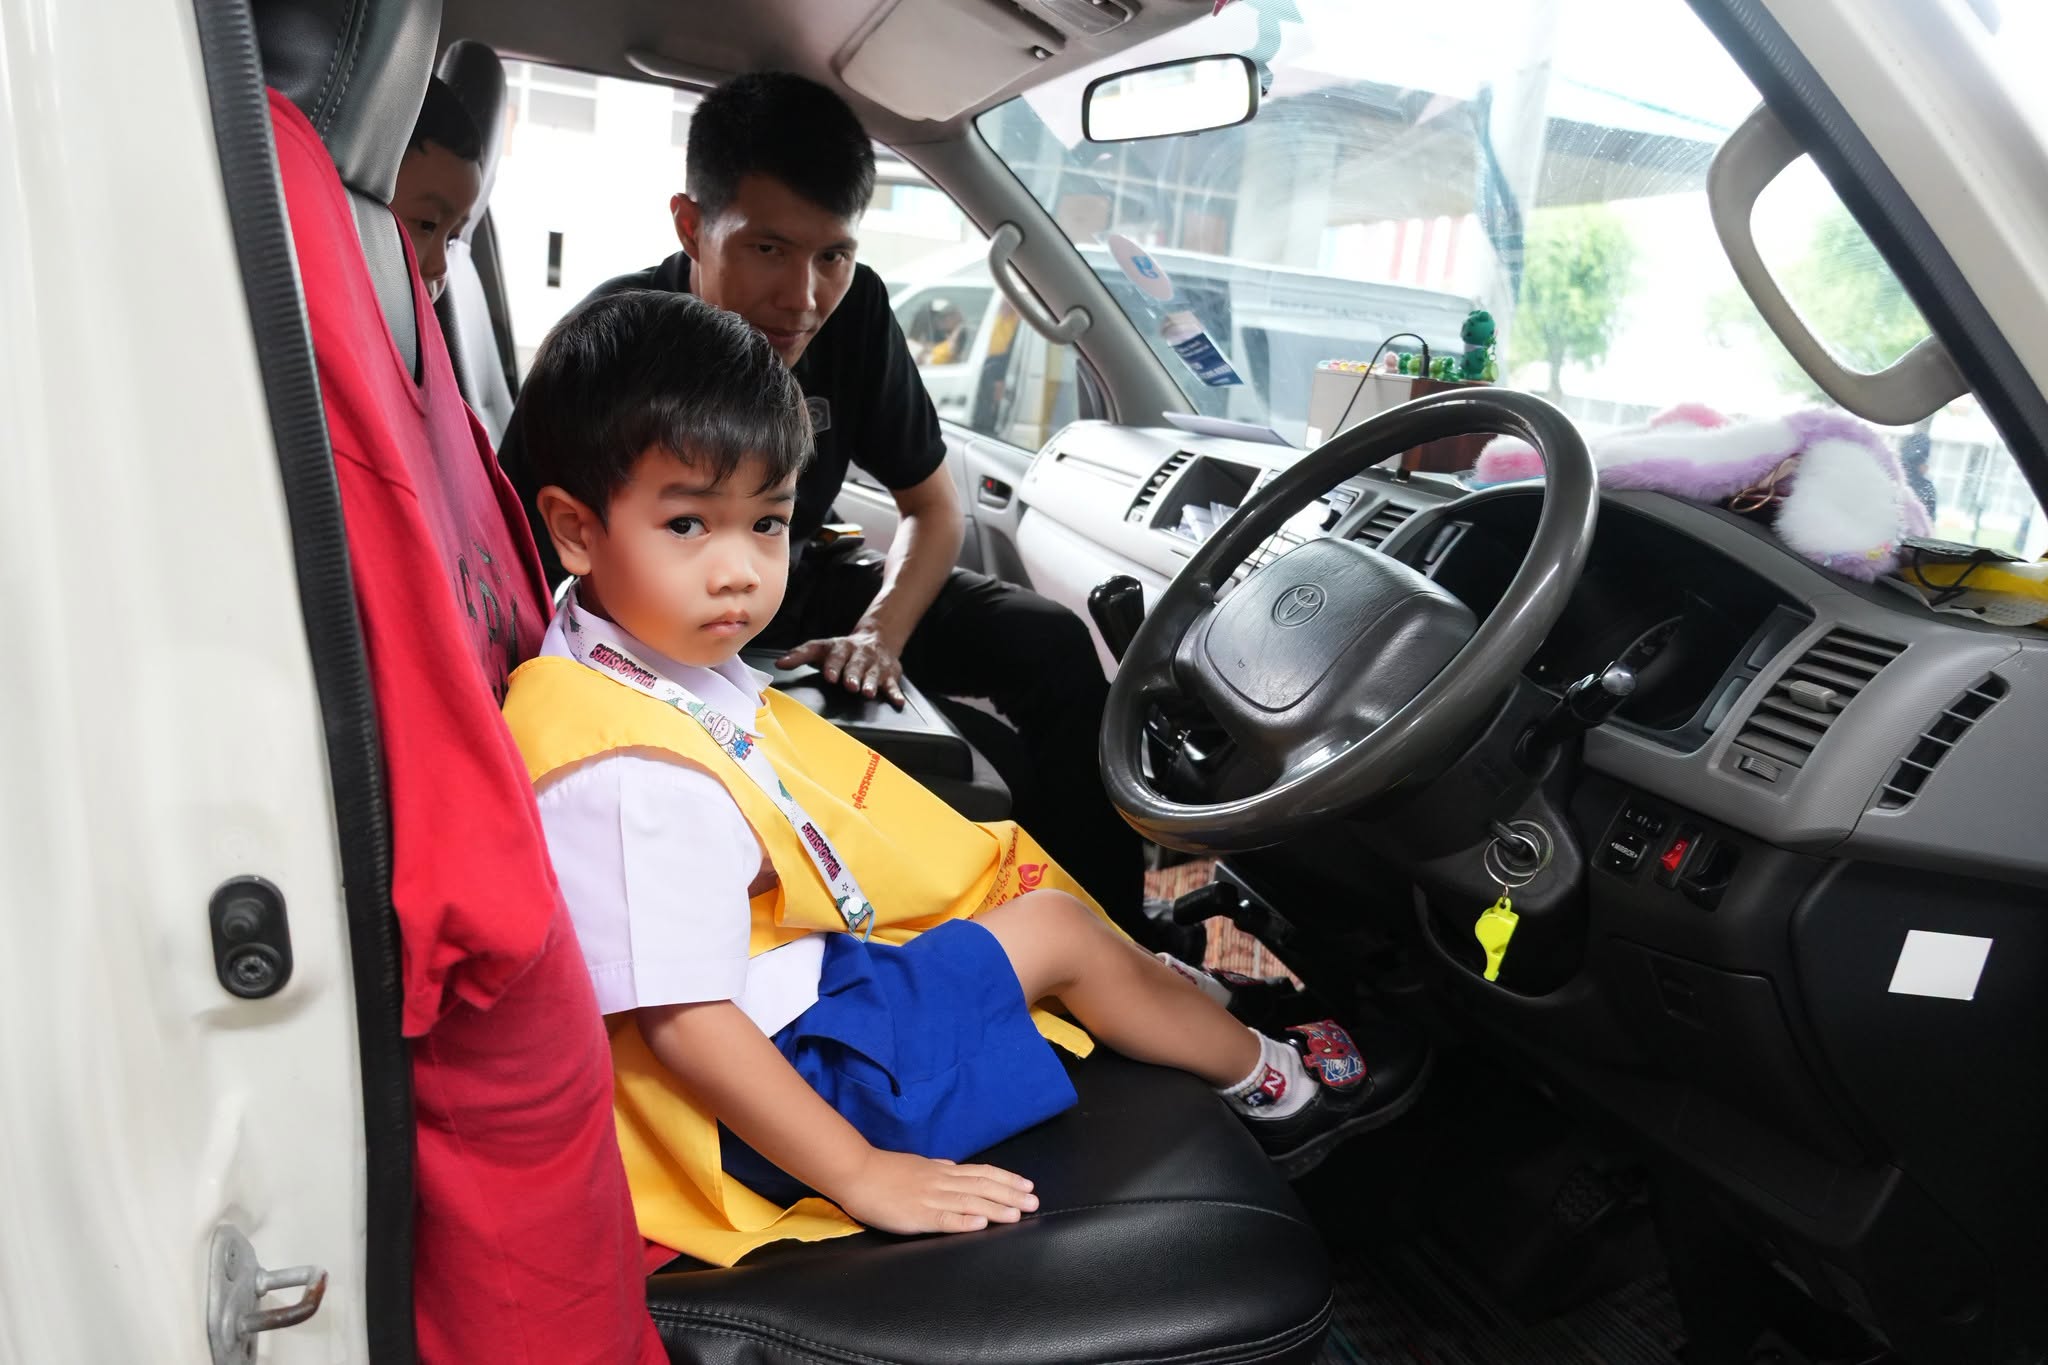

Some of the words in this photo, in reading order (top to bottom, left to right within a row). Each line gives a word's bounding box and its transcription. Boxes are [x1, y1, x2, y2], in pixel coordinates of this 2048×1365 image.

[589, 643, 640, 680] MONSTERS
[635, 669, 657, 689] THE
[801, 821, 834, 867] MONSTERS
[825, 860, 842, 881] THE
